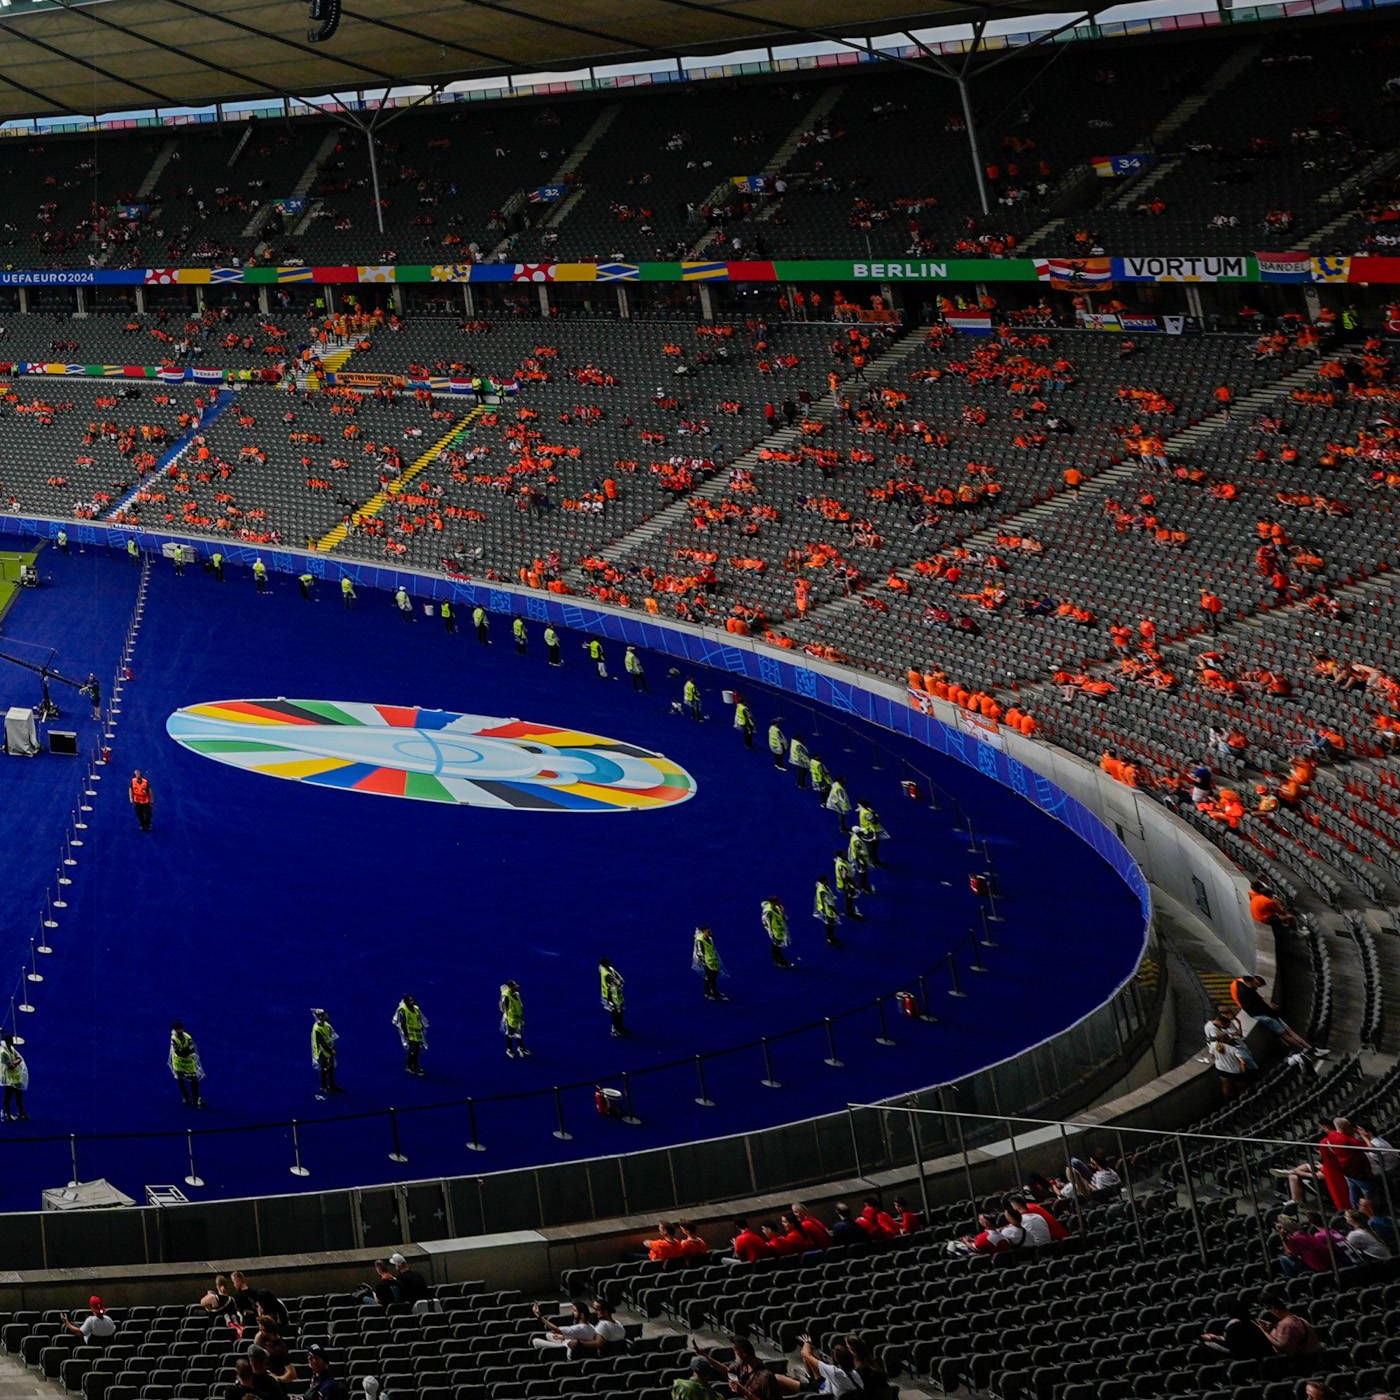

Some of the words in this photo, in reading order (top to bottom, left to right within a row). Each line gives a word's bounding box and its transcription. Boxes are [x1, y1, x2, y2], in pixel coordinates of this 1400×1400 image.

[1118, 158, 1142, 169] 34
[853, 263, 948, 278] BERLIN
[1129, 257, 1244, 277] VORTUM
[1260, 262, 1307, 273] HANDEL
